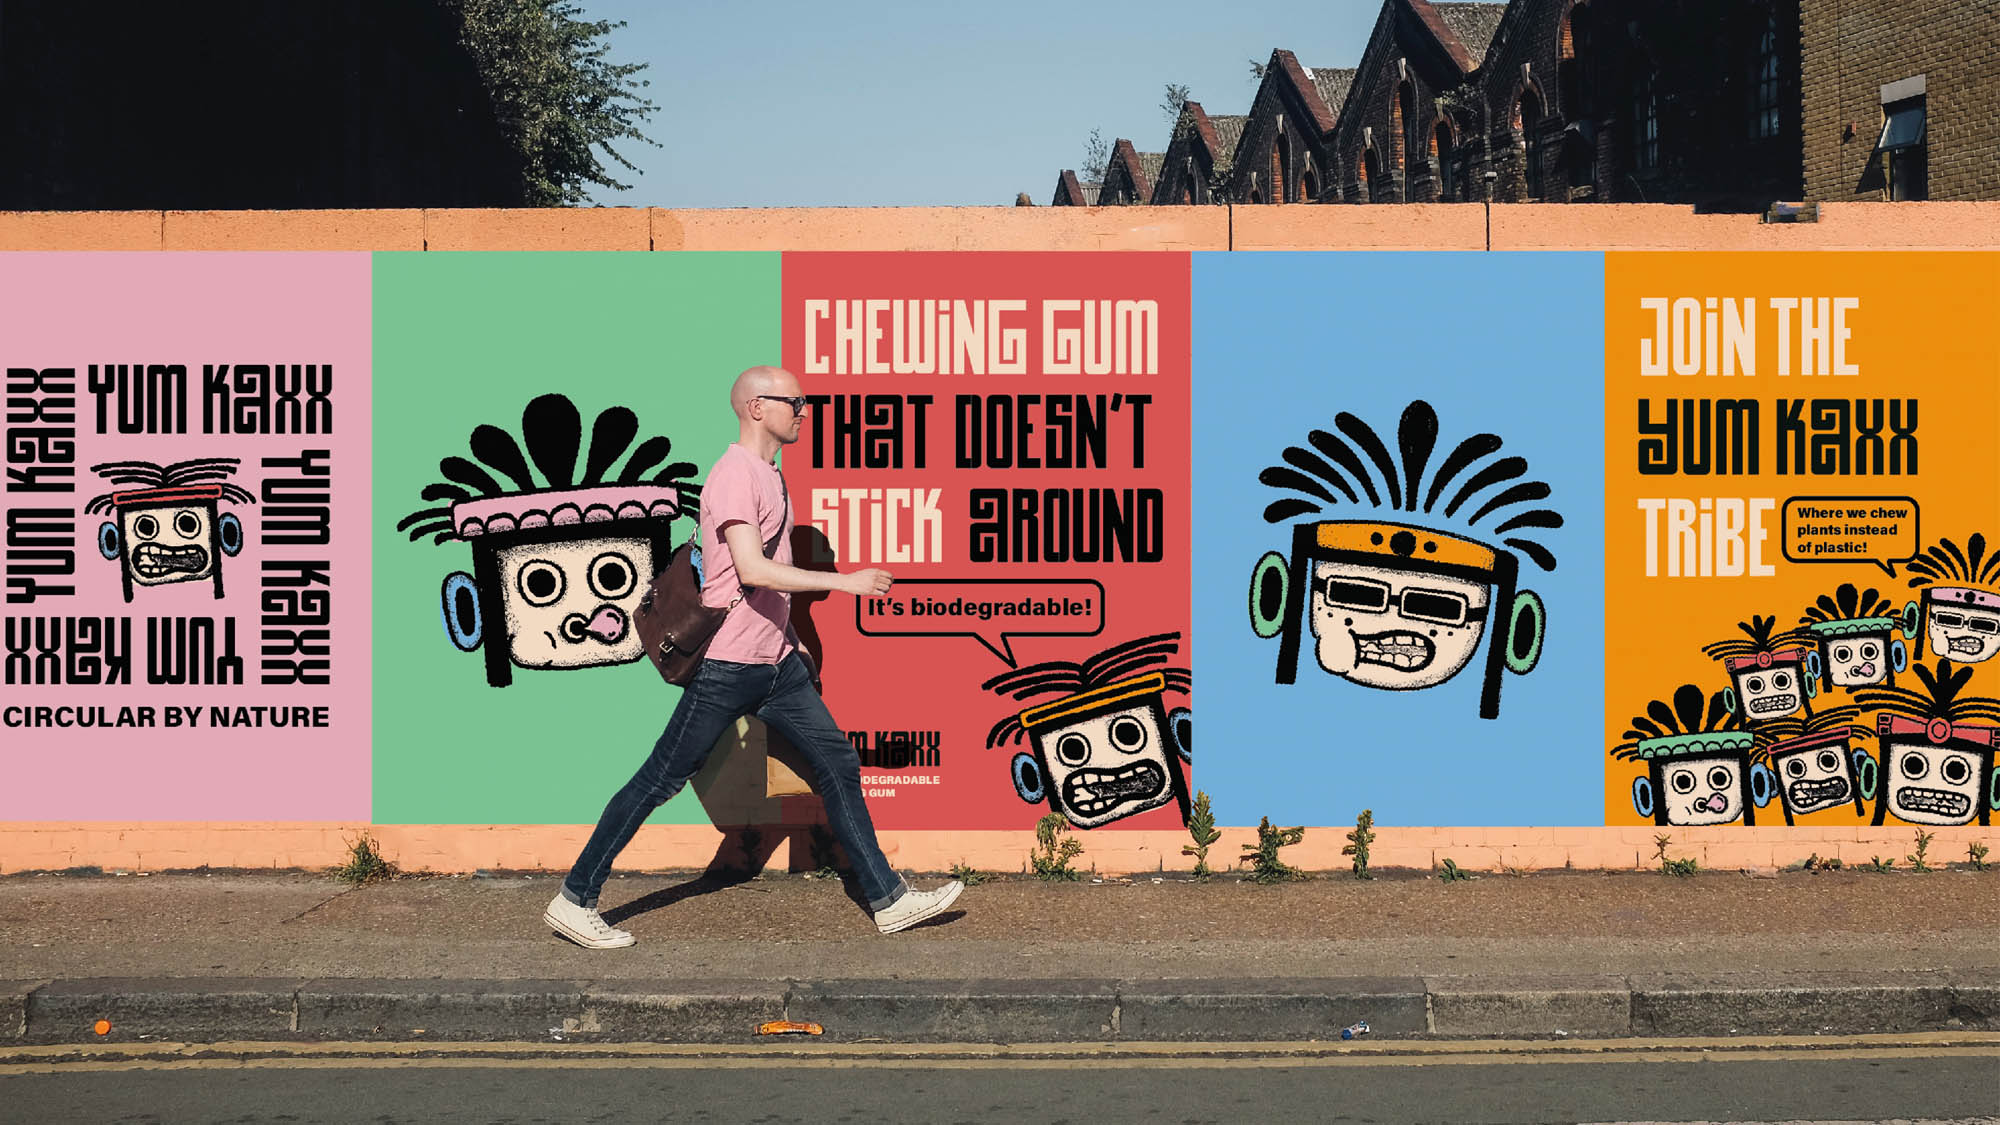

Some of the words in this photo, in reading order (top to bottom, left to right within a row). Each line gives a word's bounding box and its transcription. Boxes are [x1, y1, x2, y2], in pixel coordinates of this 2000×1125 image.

[1043, 299, 1158, 375] GUM
[1770, 297, 1859, 376] THE
[88, 364, 187, 434] YUM
[806, 394, 934, 469] THAT
[955, 392, 1153, 469] DOESN'T
[1797, 507, 1844, 519] Where
[1846, 508, 1868, 519] we
[1870, 507, 1908, 519] chew
[969, 488, 1164, 563] AROUND
[1797, 523, 1842, 538] plants
[1844, 523, 1898, 537] instead
[1797, 541, 1812, 553] of
[1814, 541, 1867, 555] plastic!
[868, 597, 905, 616] It's
[911, 597, 1092, 620] biodegradable!
[3, 706, 156, 728] CIRCULAR
[164, 706, 203, 728] BY
[210, 706, 329, 728] NATURE
[860, 775, 941, 785] DEGRADABLE
[868, 788, 896, 798] GUM
